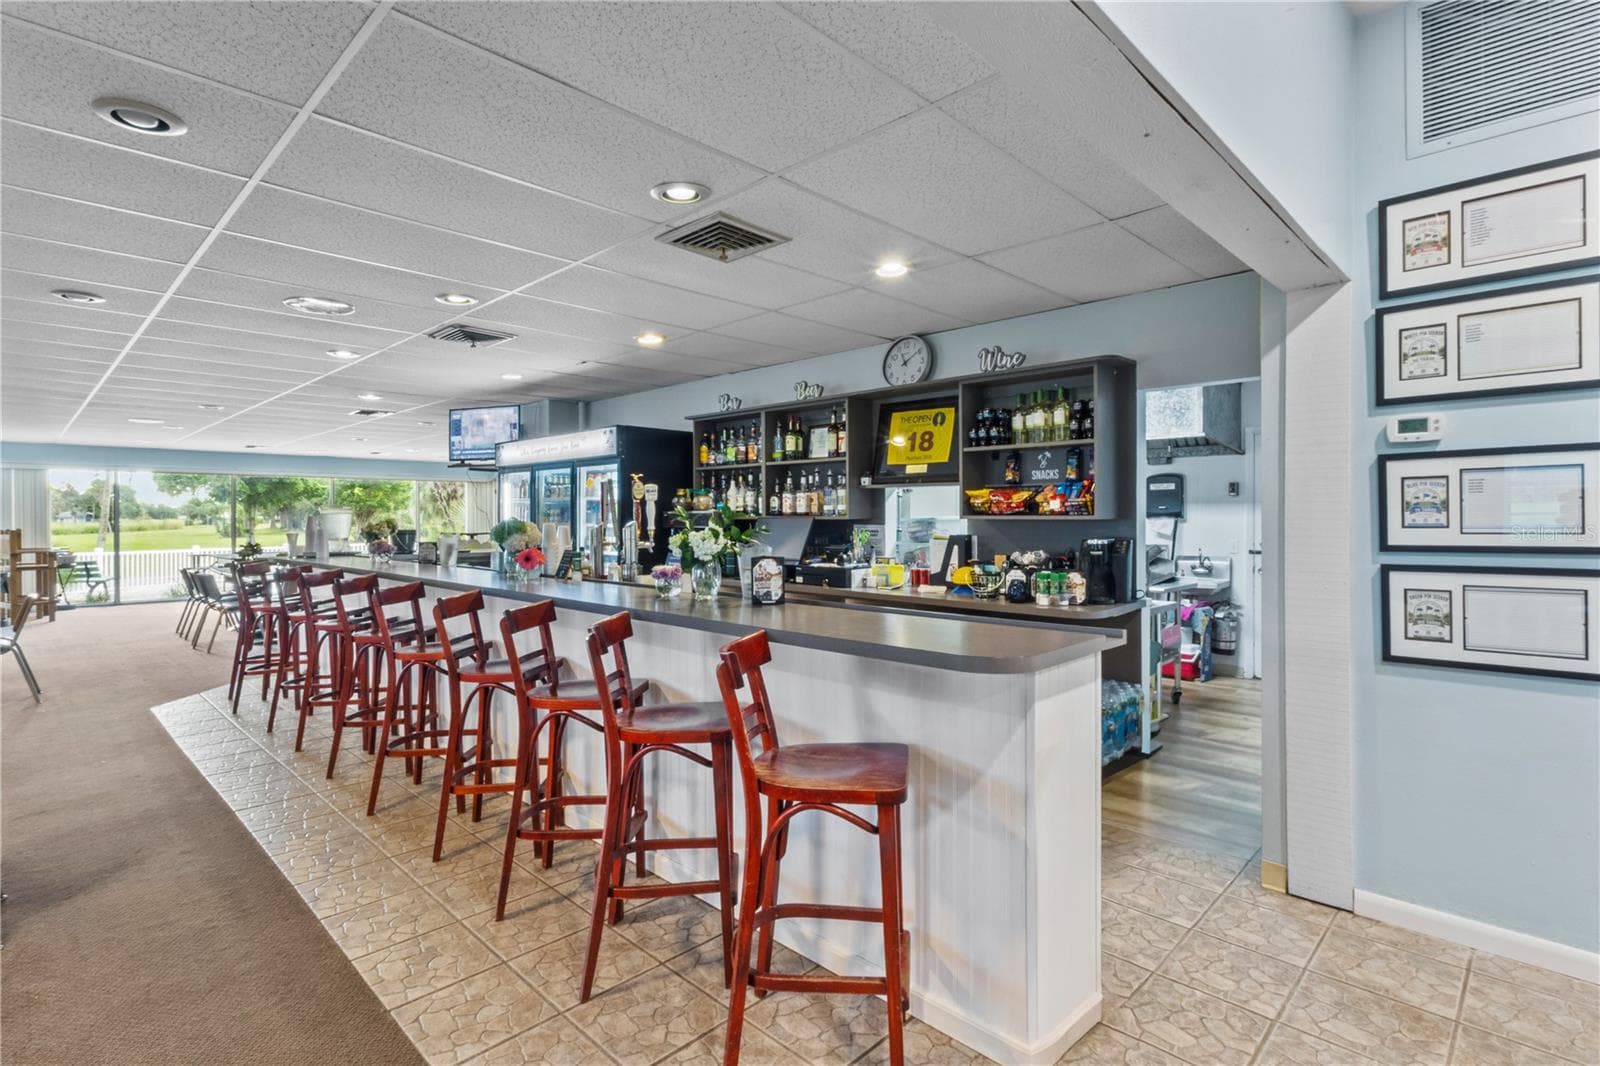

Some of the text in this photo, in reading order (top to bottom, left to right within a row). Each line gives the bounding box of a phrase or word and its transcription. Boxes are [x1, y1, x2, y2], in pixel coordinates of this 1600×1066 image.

[978, 346, 1026, 371] Wine
[794, 380, 824, 400] Beer
[912, 415, 932, 424] OPEN
[908, 430, 934, 452] 18
[1031, 468, 1060, 480] SNACKS
